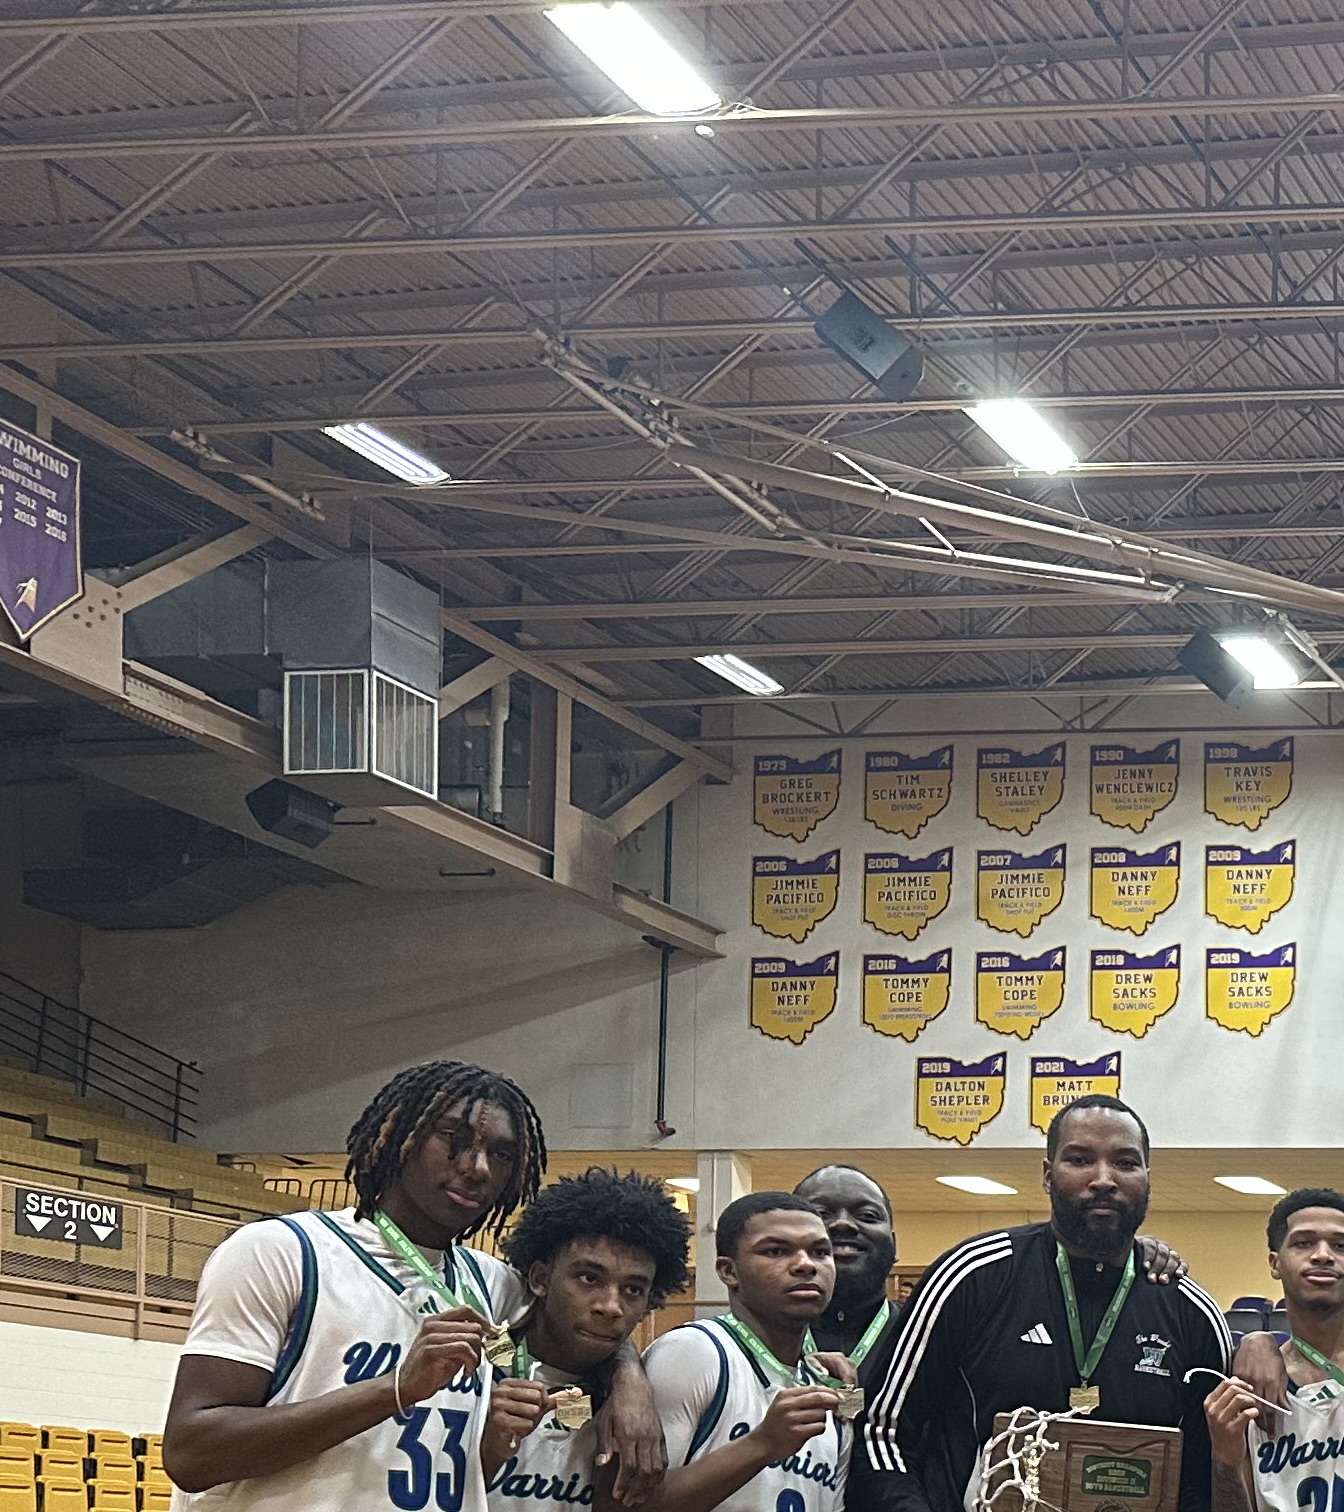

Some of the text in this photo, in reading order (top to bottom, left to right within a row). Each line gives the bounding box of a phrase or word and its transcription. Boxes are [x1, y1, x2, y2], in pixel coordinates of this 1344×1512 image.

[991, 771, 1049, 782] SHELLEY
[1114, 768, 1153, 780] JENNY
[1224, 766, 1272, 777] TRAVIS
[780, 778, 813, 789] GREG
[1095, 782, 1173, 794] WENCLEWICZ
[1235, 780, 1262, 792] KEY
[762, 791, 831, 804] BROCKERT
[872, 788, 944, 800] SCHWARTZ
[995, 786, 1044, 797] STALEY
[997, 873, 1044, 885] JIMMIE
[1111, 871, 1157, 882] DANNY
[1226, 869, 1272, 880] DANNY
[772, 878, 818, 891] JIMMIE
[884, 876, 931, 888] JIMMIE
[991, 887, 1050, 899] PACIFICO
[1118, 885, 1152, 896] NEFF
[1232, 883, 1267, 895] NEFF
[765, 893, 824, 905] PACIFICO
[877, 890, 936, 902] PACIFICO
[883, 977, 930, 989] TOMMY
[996, 975, 1043, 986] TOMMY
[1115, 973, 1153, 984] DREW
[1231, 971, 1269, 983] DREW
[771, 980, 816, 992] DANNY
[1228, 986, 1272, 997] SACKS
[889, 991, 922, 1003] COPE
[1004, 990, 1037, 1001] COPE
[1113, 987, 1157, 999] SACKS
[777, 995, 810, 1006] NEFF
[935, 1081, 986, 1092] DALTON
[1056, 1080, 1093, 1091] MATT
[930, 1095, 990, 1106] SHEPLER
[25, 1193, 116, 1225] SECTION
[64, 1220, 77, 1240] 2
